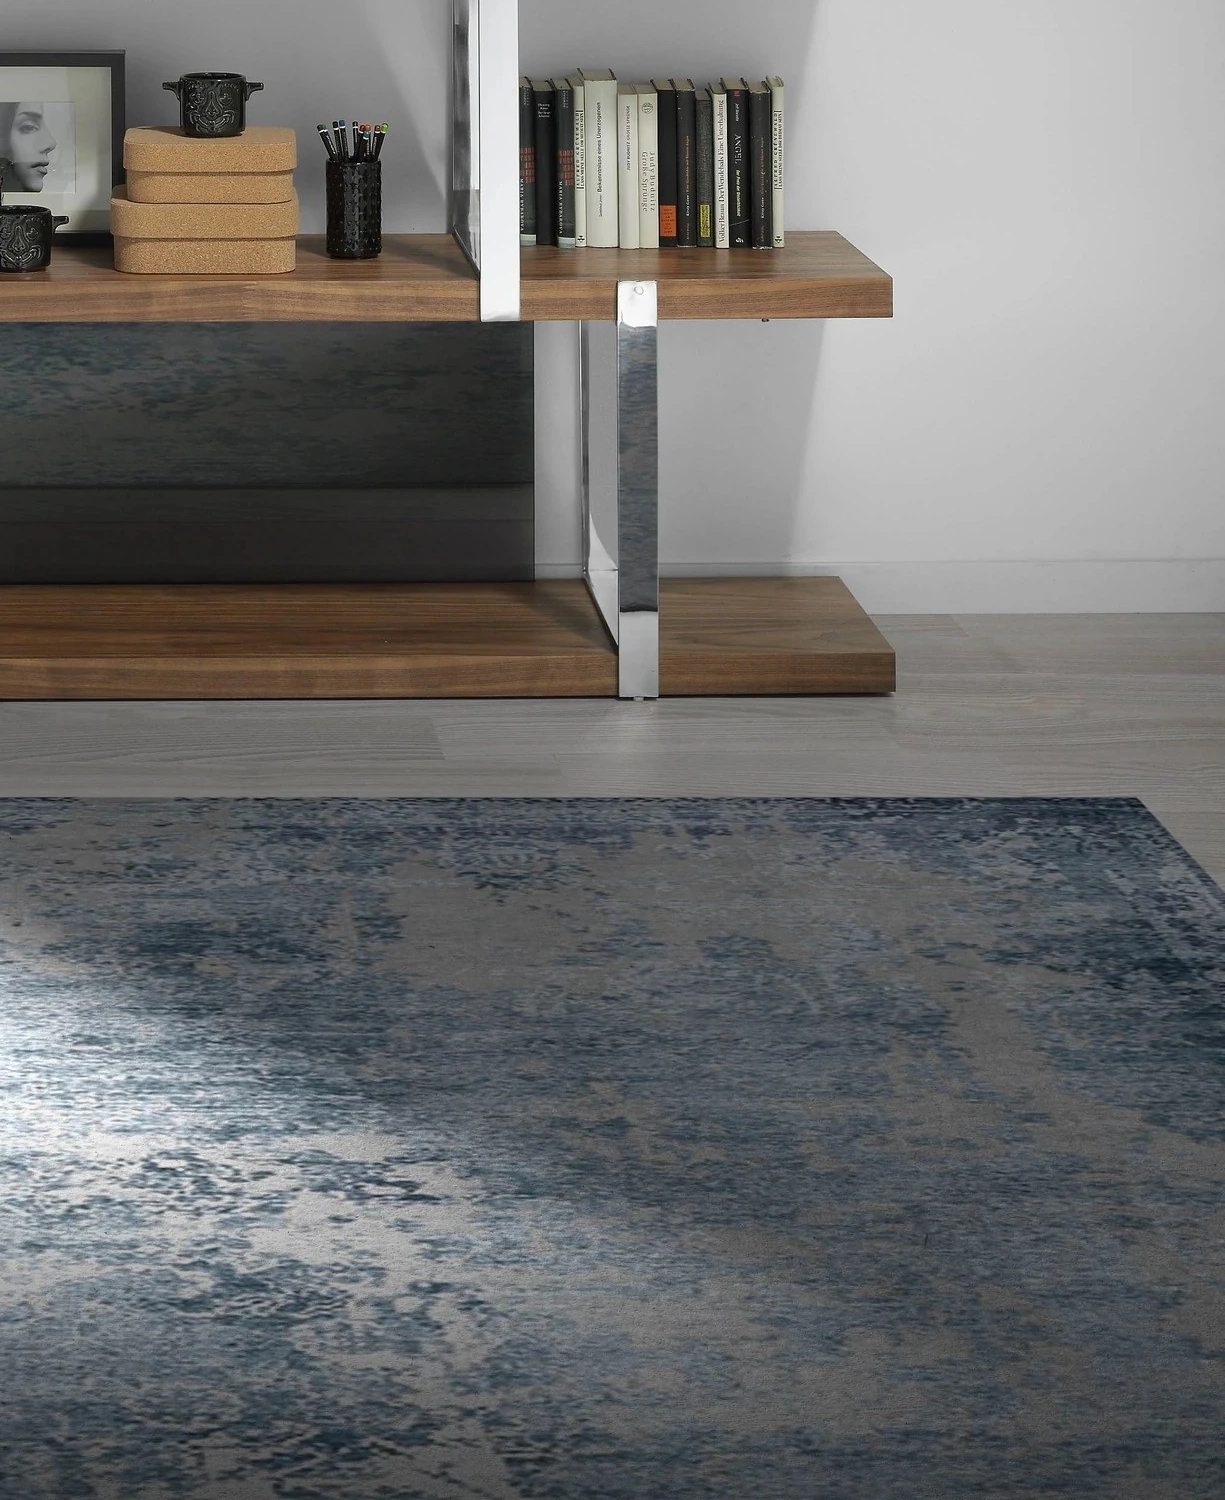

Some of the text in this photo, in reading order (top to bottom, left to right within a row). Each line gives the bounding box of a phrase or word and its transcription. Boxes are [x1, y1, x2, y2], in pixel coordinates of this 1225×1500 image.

[716, 99, 724, 141] Unterhaltung
[734, 134, 742, 164] ANGEL
[640, 178, 649, 212] Sprünge
